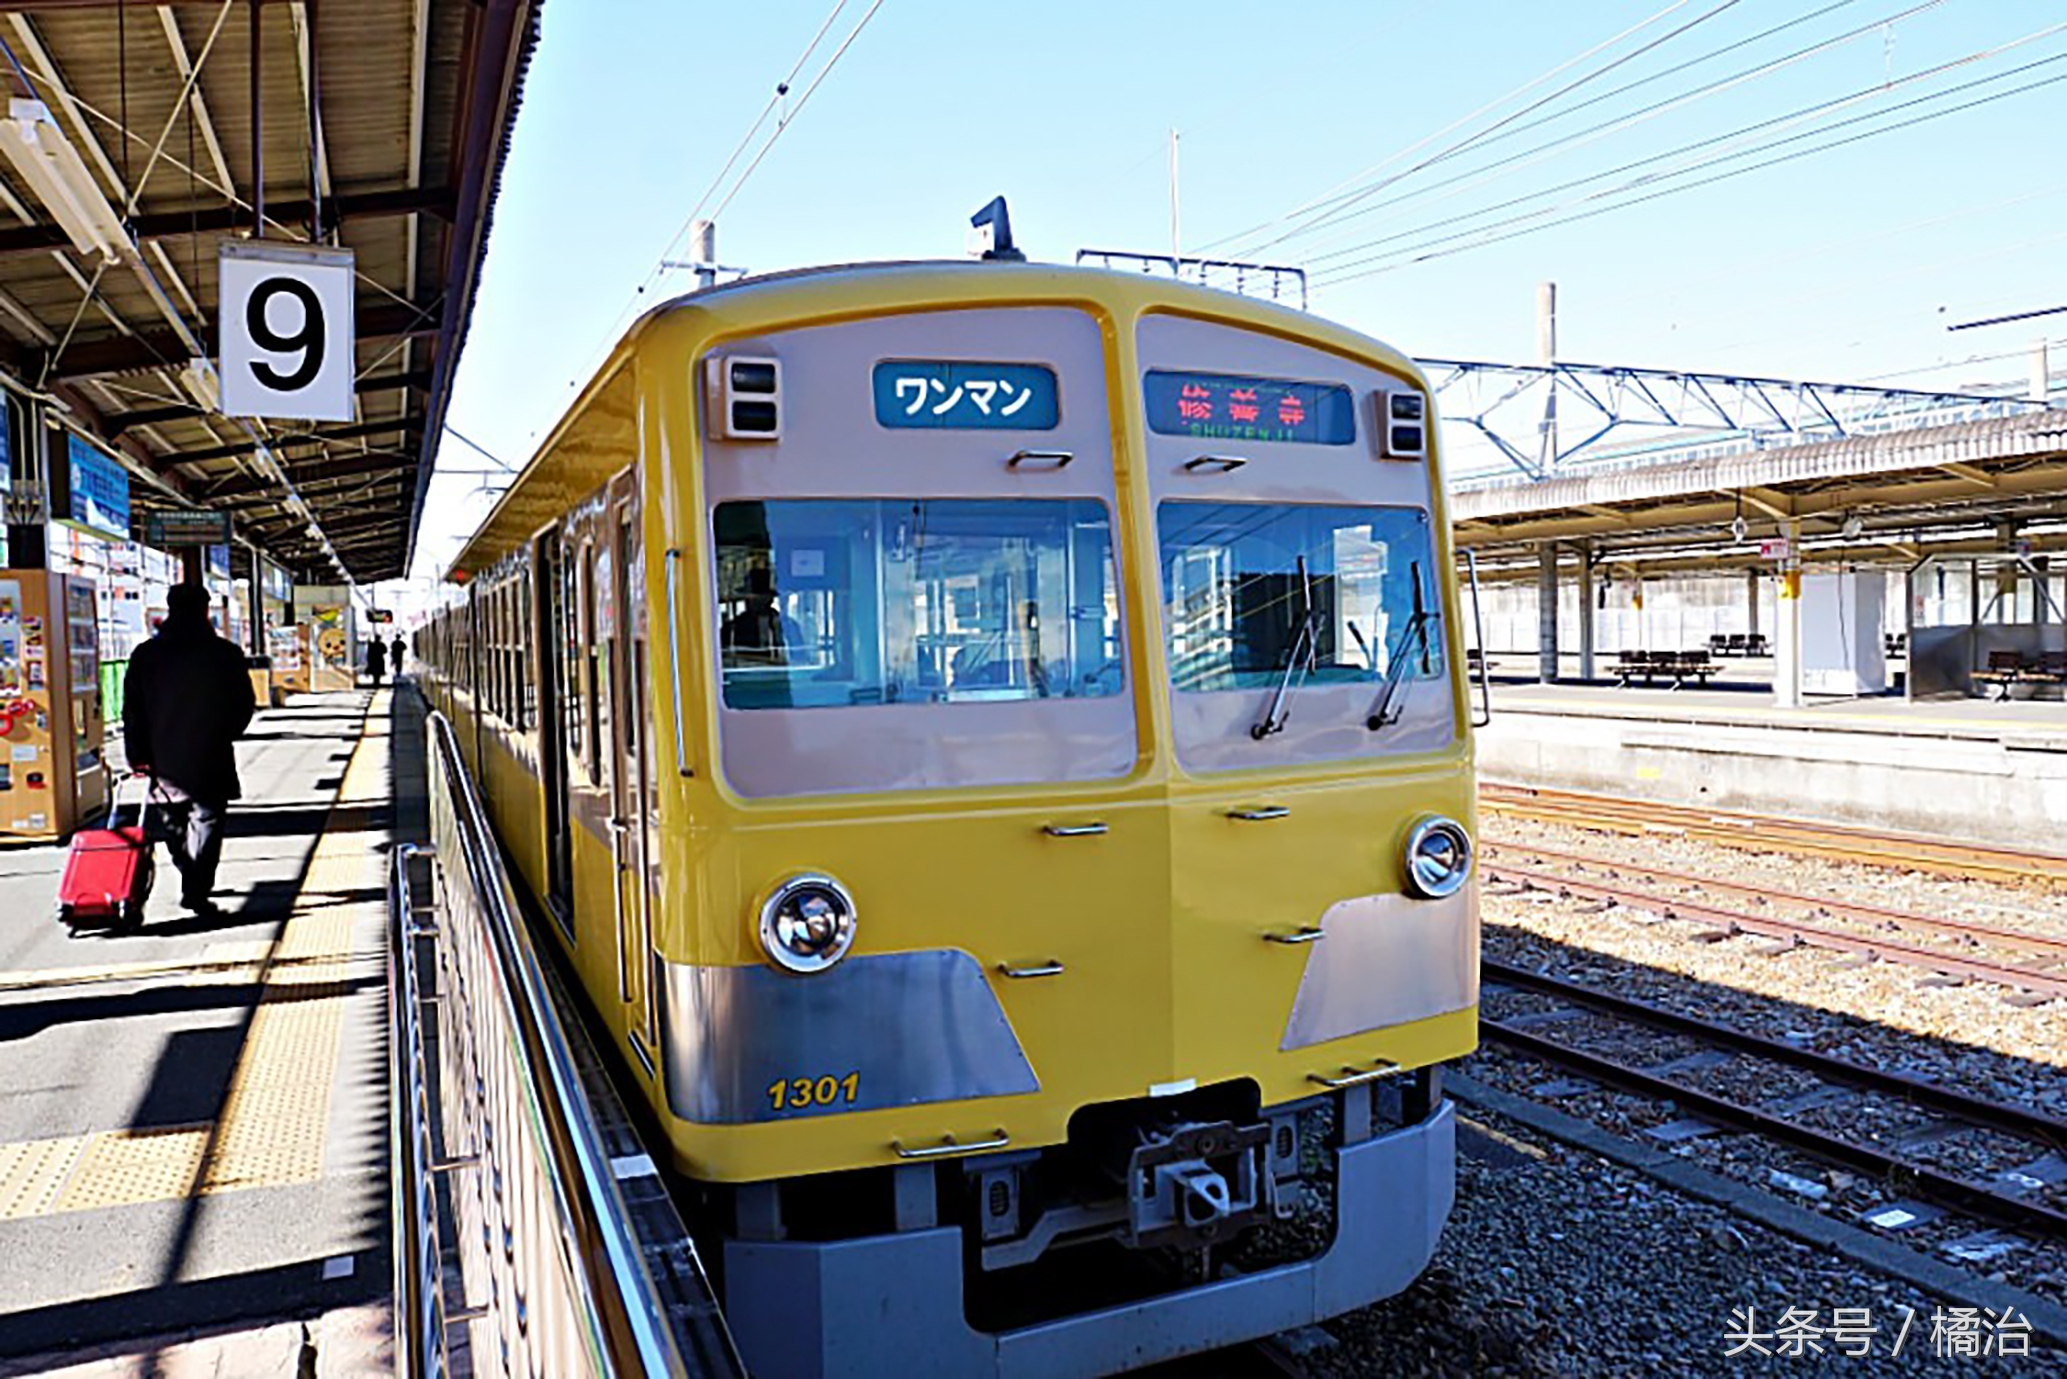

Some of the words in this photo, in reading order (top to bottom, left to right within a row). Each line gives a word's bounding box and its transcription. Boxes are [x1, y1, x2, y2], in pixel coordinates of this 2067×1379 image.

[246, 276, 326, 392] 9
[896, 377, 1032, 417] ワンマン
[767, 1070, 860, 1111] 1301
